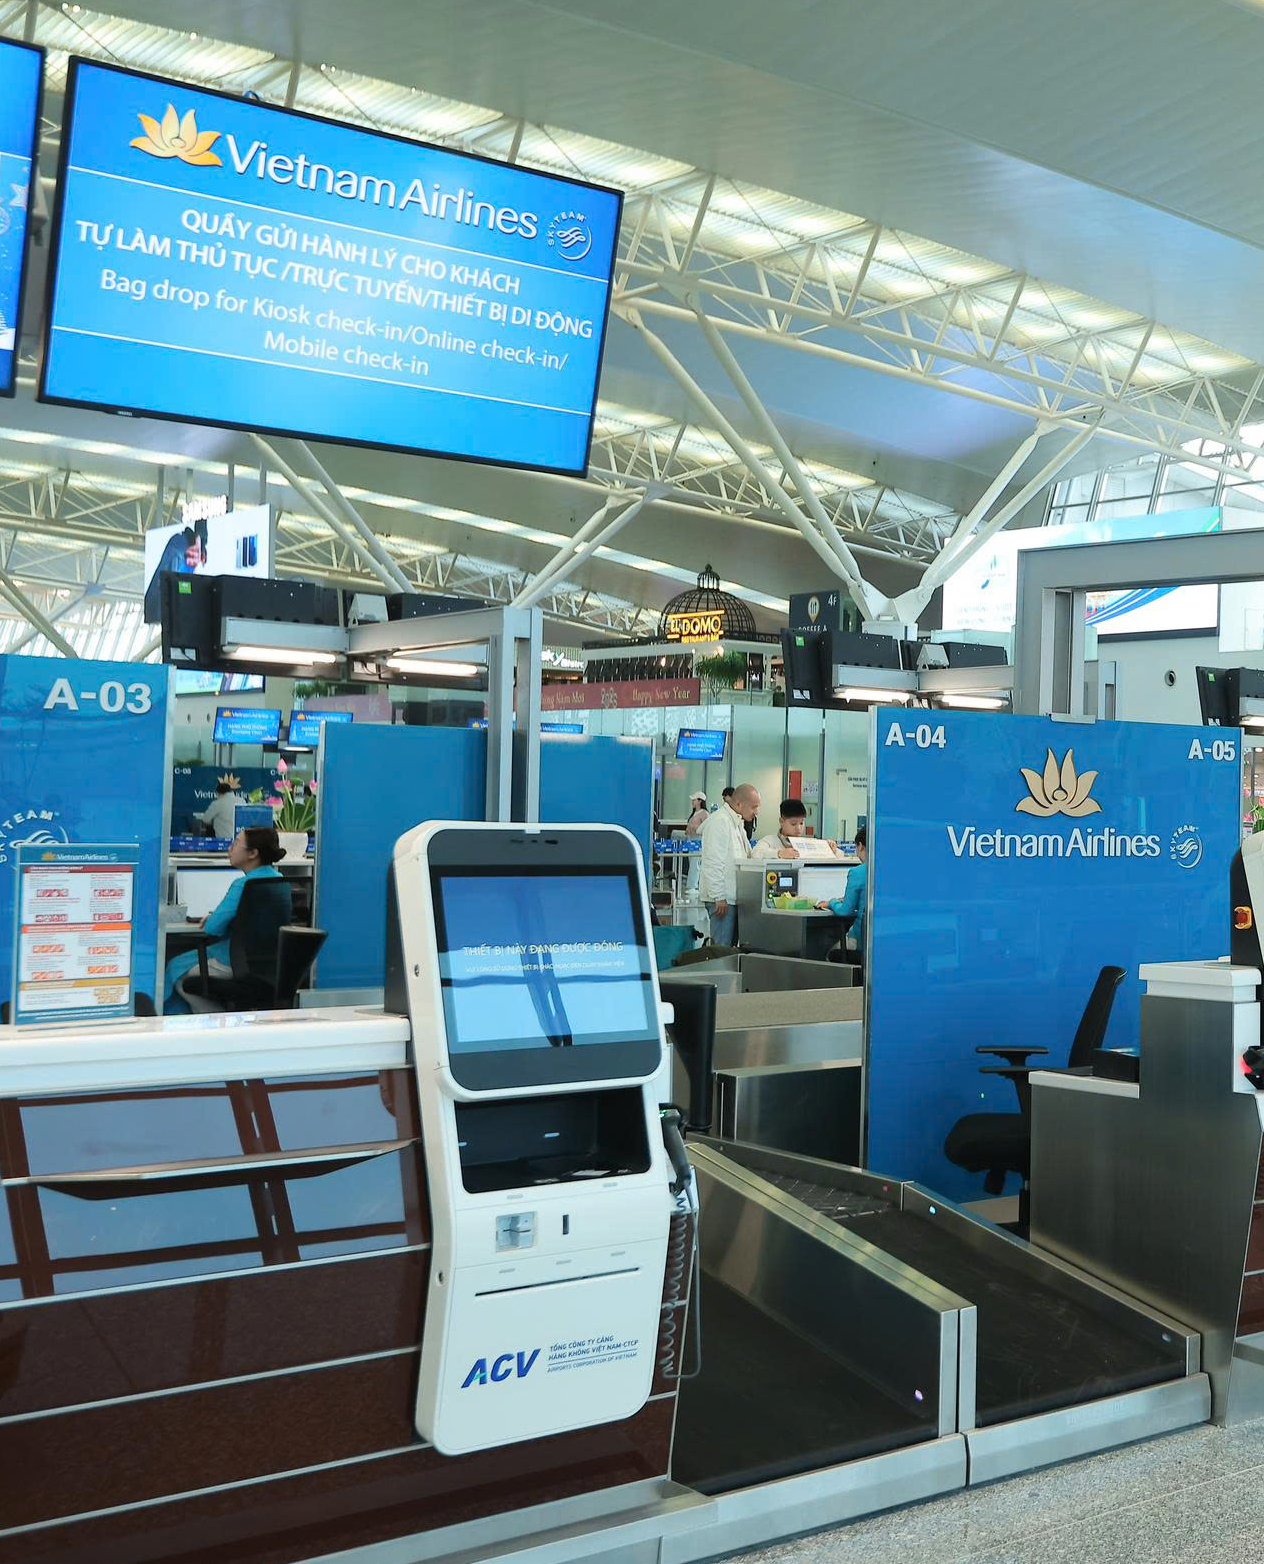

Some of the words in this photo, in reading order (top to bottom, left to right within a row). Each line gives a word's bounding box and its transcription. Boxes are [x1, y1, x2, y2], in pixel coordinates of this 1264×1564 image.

[225, 133, 395, 209] Vietnam
[399, 176, 538, 240] Airlines
[256, 222, 297, 251] GỬI
[301, 232, 367, 265] HÀNH
[371, 247, 397, 270] LÝ
[401, 254, 447, 281] CHO
[450, 264, 521, 295] KHÁCH
[76, 219, 113, 251] TỰ
[116, 226, 171, 259] LÀM
[176, 238, 226, 268] THỦ
[488, 302, 508, 328] BỊ
[511, 306, 532, 328] DI
[534, 309, 594, 339] ĐỘNG
[100, 268, 147, 301] Bag
[152, 279, 210, 312] drop
[215, 289, 248, 314] for
[252, 296, 311, 325] Kiosk
[315, 306, 476, 355] check-in/Online
[481, 338, 570, 372] check-in/
[264, 330, 339, 361] Mobile
[343, 346, 430, 376] check-in
[671, 619, 680, 633] EL
[682, 616, 721, 635] DOMO
[43, 677, 152, 714] A-03
[673, 685, 690, 699] Year
[885, 722, 946, 750] A-04
[1187, 738, 1235, 762] A-05
[947, 825, 1065, 858] Vietnam
[1065, 827, 1161, 858] Airlines
[464, 943, 492, 956] THIẾT
[505, 942, 527, 956] NÀY
[529, 944, 559, 955] ĐANG
[562, 942, 591, 954] ĐƯỢC
[595, 940, 623, 952] ĐÓNG
[569, 1340, 585, 1349] CÔNG
[461, 1348, 541, 1388] ACV
